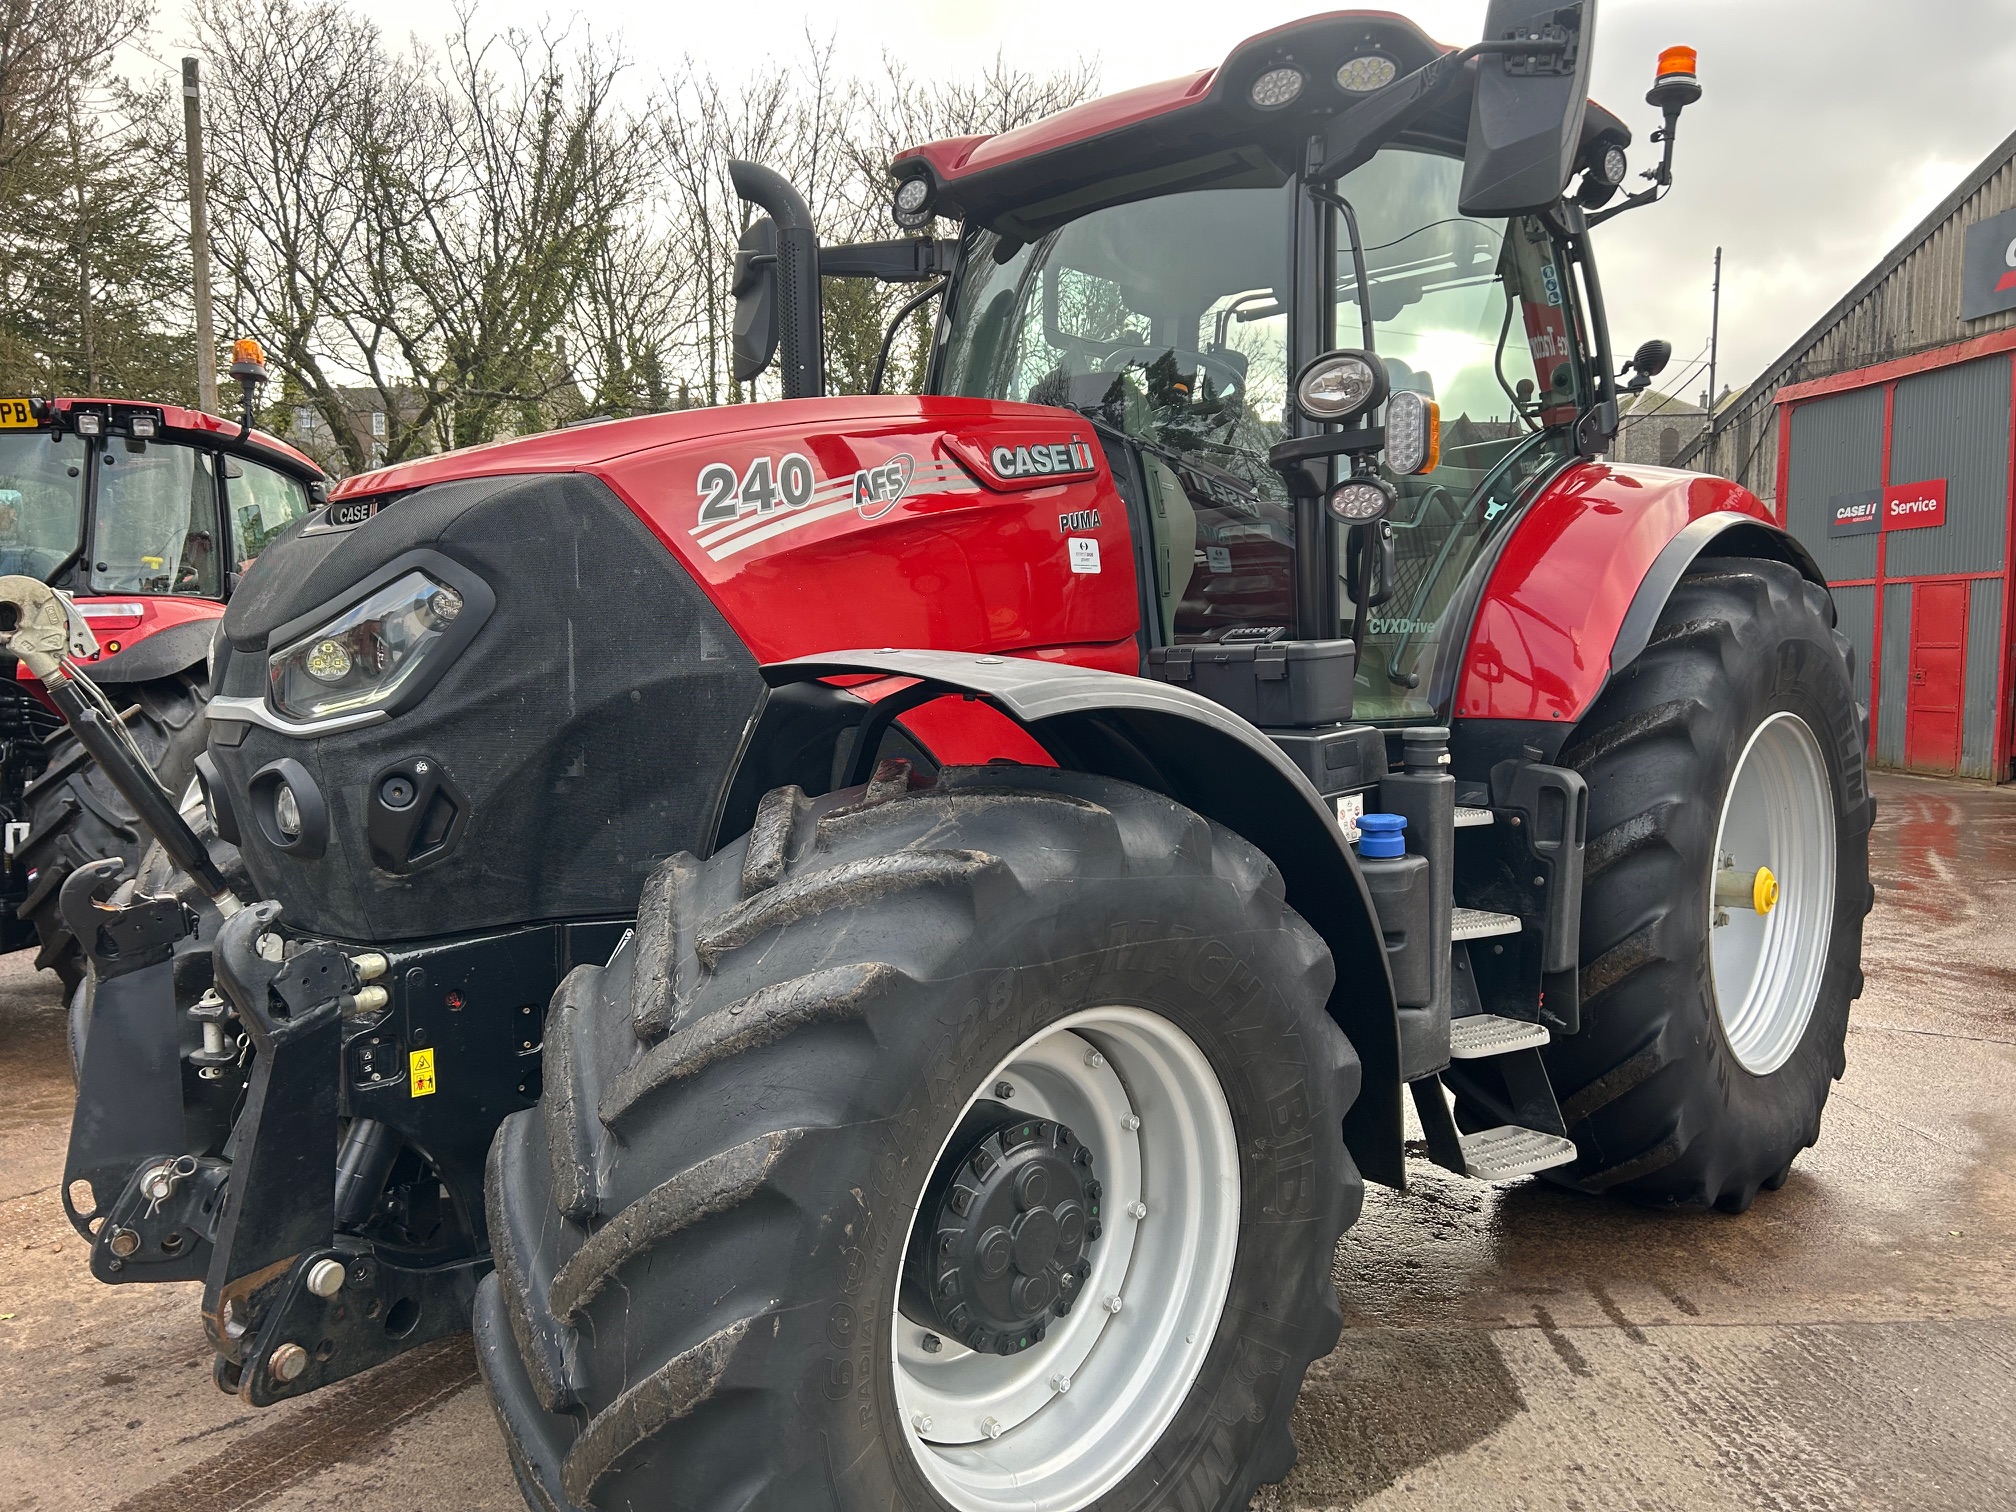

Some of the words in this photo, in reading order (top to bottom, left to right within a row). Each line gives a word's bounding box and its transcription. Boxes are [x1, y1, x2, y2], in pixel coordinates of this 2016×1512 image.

[992, 444, 1071, 477] CASE
[697, 453, 815, 525] 240
[853, 463, 905, 508] AFS
[340, 504, 368, 523] CASE
[1836, 504, 1867, 519] CASE
[1890, 497, 1937, 516] Service
[1059, 509, 1102, 534] PUMA
[1369, 618, 1436, 634] CVXDrive
